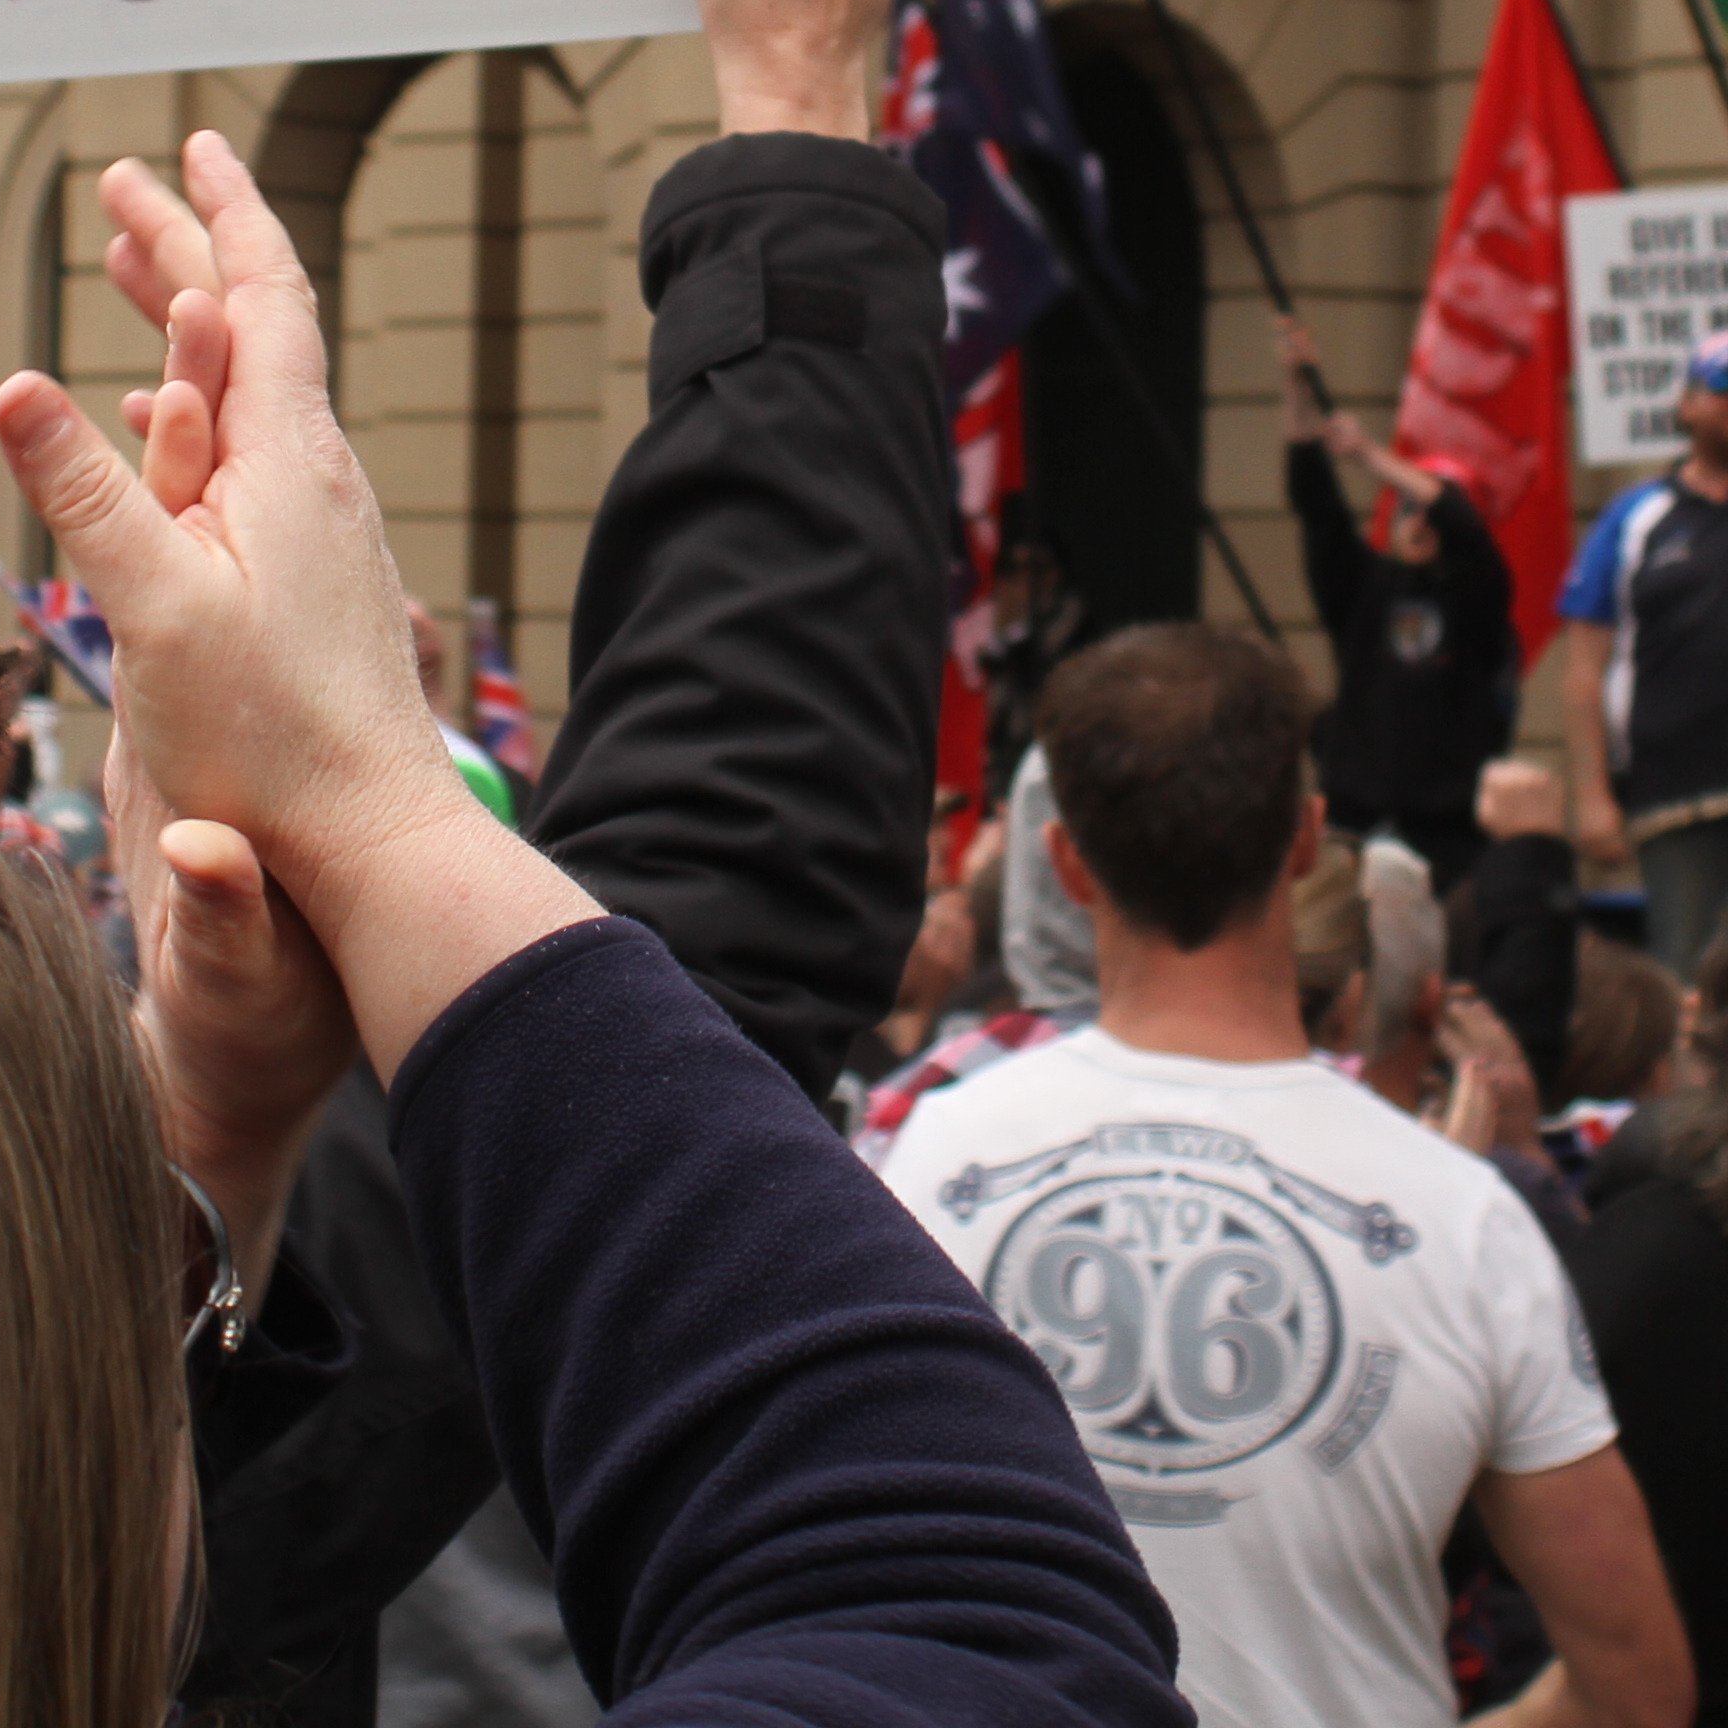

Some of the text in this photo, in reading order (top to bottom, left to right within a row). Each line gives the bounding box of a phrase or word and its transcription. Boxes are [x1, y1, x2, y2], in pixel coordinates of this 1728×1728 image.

[1631, 213, 1693, 253] GIVE
[1589, 313, 1625, 349] ON
[1643, 308, 1691, 346] THE
[1604, 355, 1672, 398] STOP
[1027, 1234, 1287, 1423] 96
